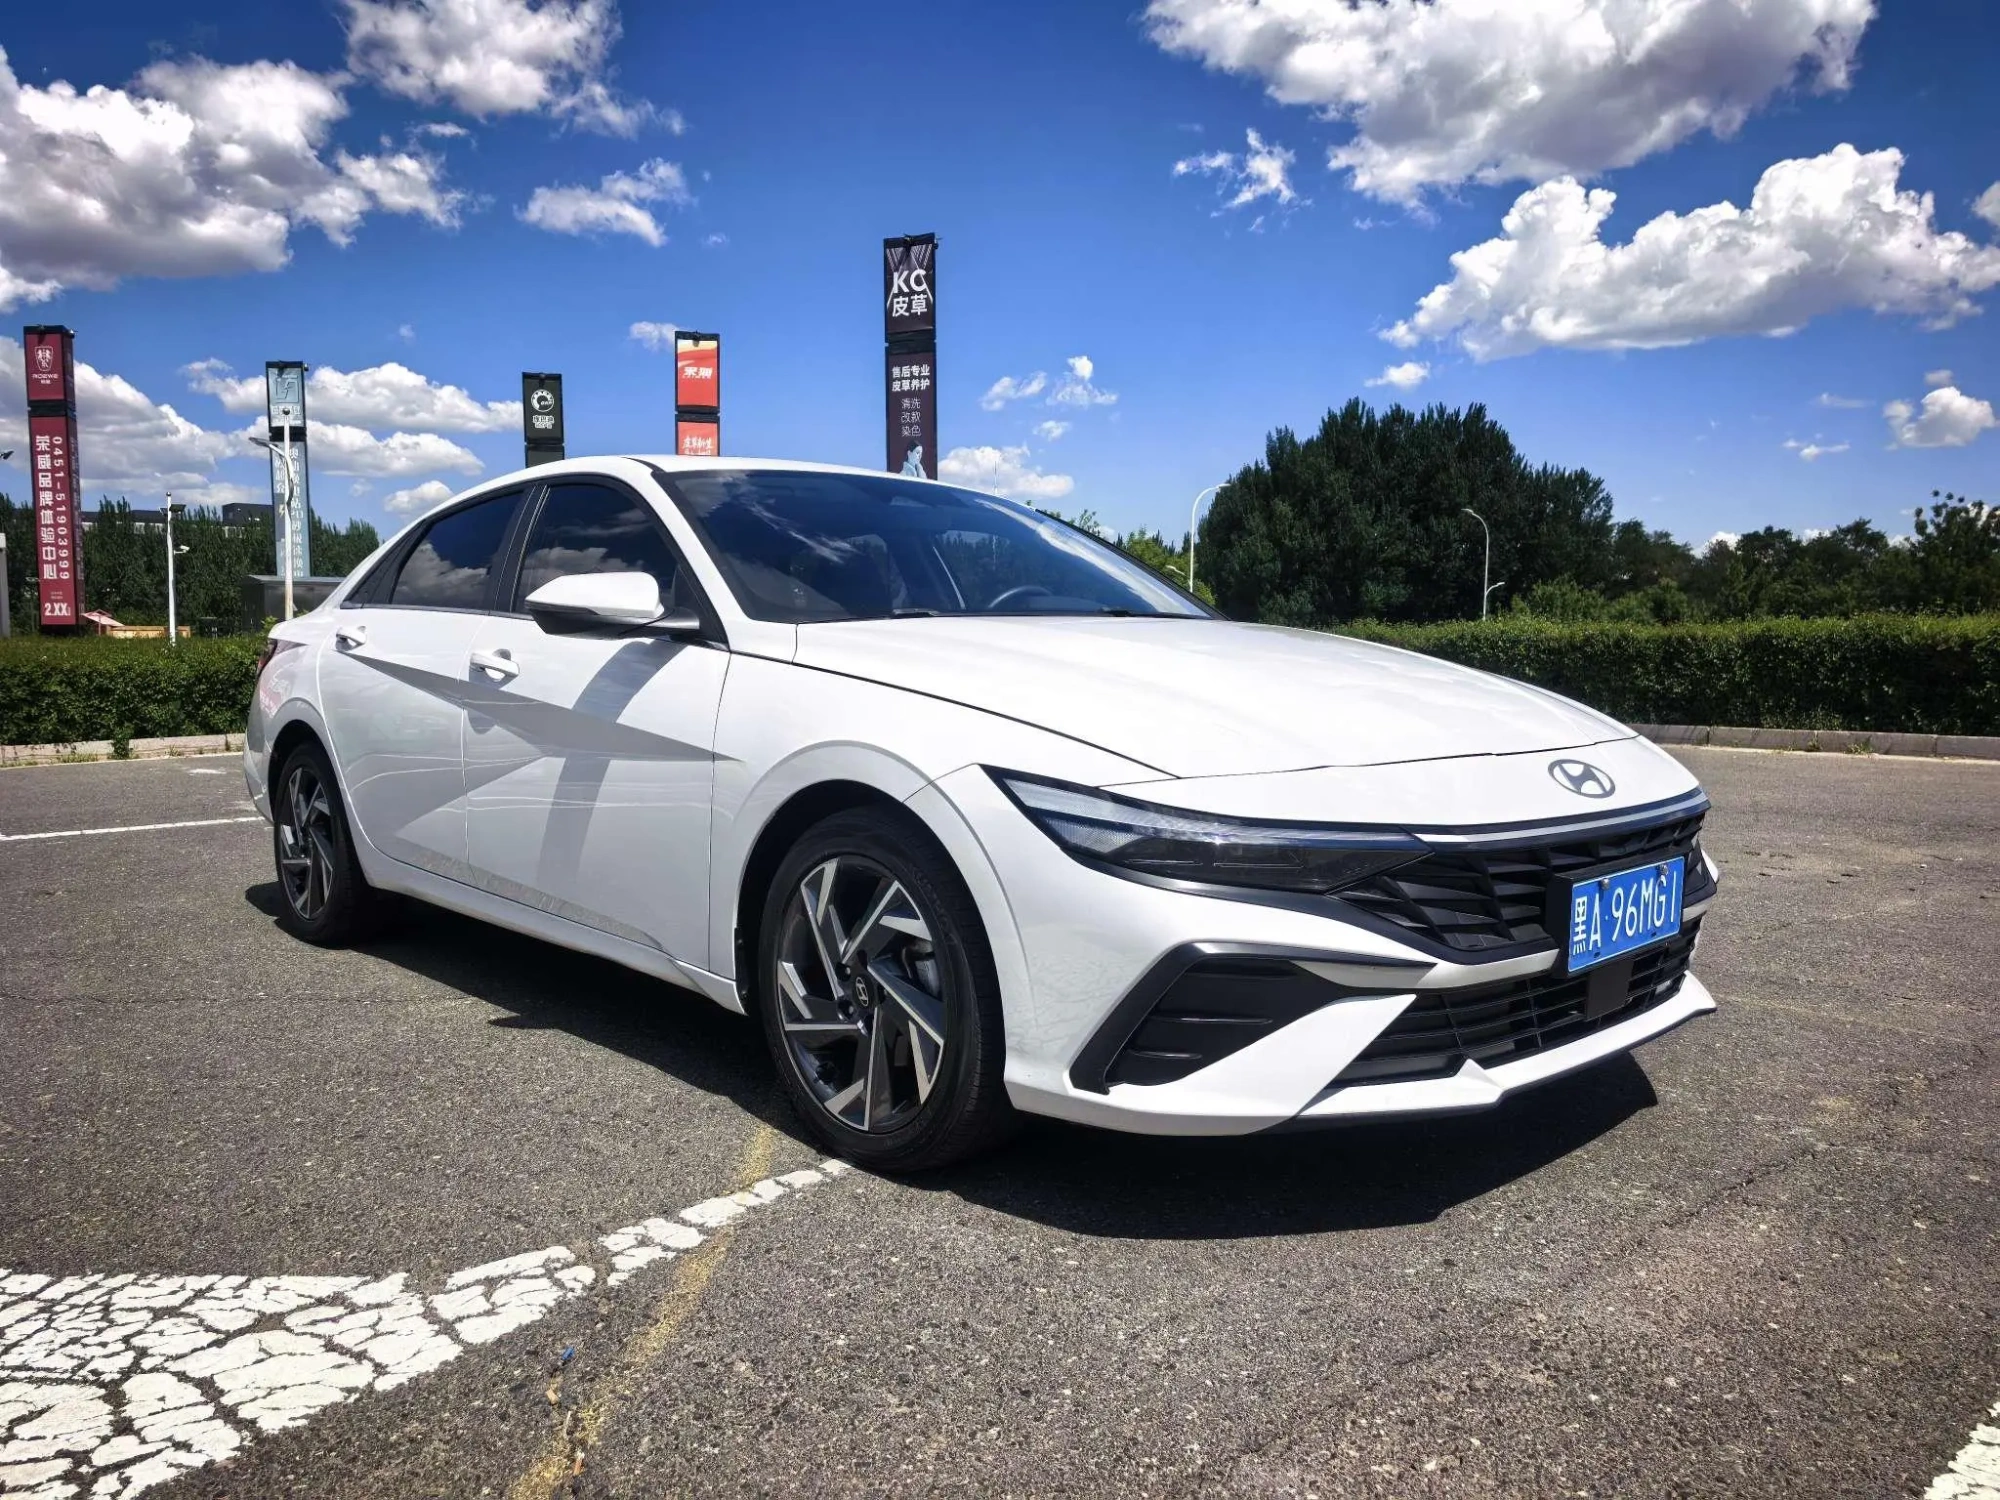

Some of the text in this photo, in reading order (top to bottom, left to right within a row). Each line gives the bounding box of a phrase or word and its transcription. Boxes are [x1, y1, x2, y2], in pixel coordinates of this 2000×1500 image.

[892, 268, 927, 293] KC
[892, 293, 928, 317] 皮草
[891, 364, 930, 379] 售后专业
[891, 378, 930, 392] 皮草养护
[901, 398, 921, 410] 清洗
[900, 411, 921, 423] 改款
[901, 425, 921, 437] 染色
[35, 435, 57, 579] 荣威品牌体验中心
[52, 436, 70, 579] 0451-51903999
